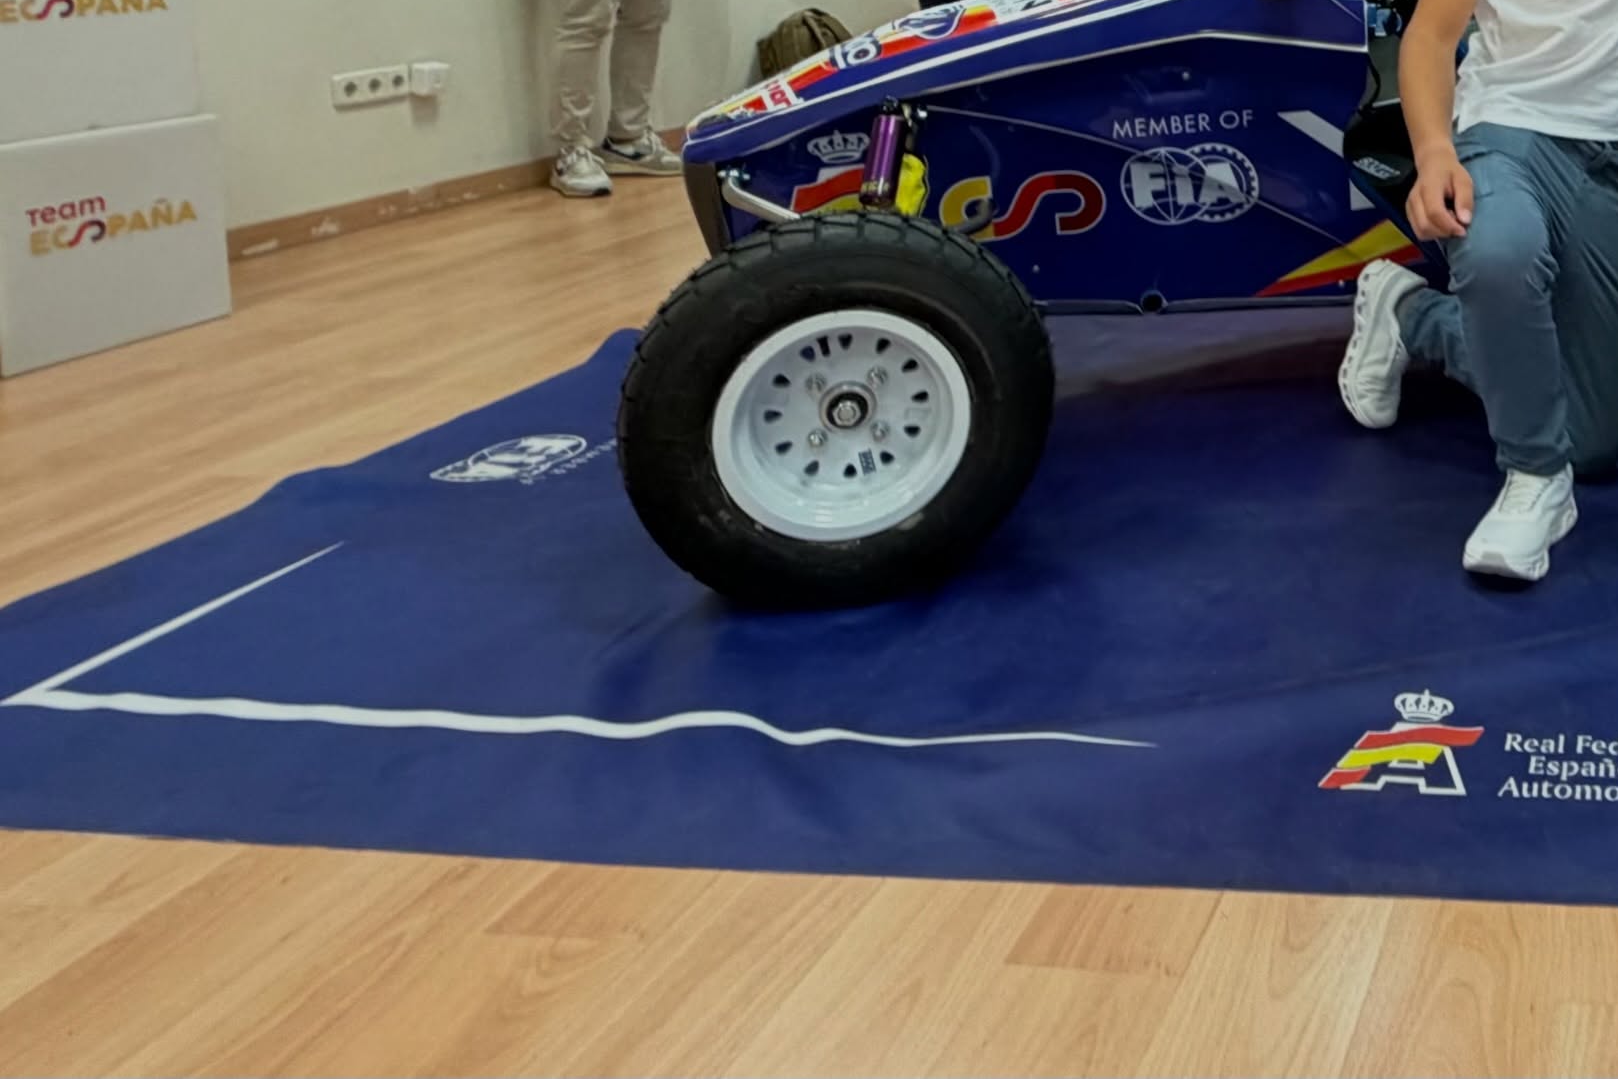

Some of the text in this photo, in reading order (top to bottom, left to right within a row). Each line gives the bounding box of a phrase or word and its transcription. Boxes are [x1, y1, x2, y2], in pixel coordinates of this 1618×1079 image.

[1112, 110, 1253, 139] MEMBER OF
[1130, 162, 1248, 209] FIA
[1504, 733, 1565, 754] Real
